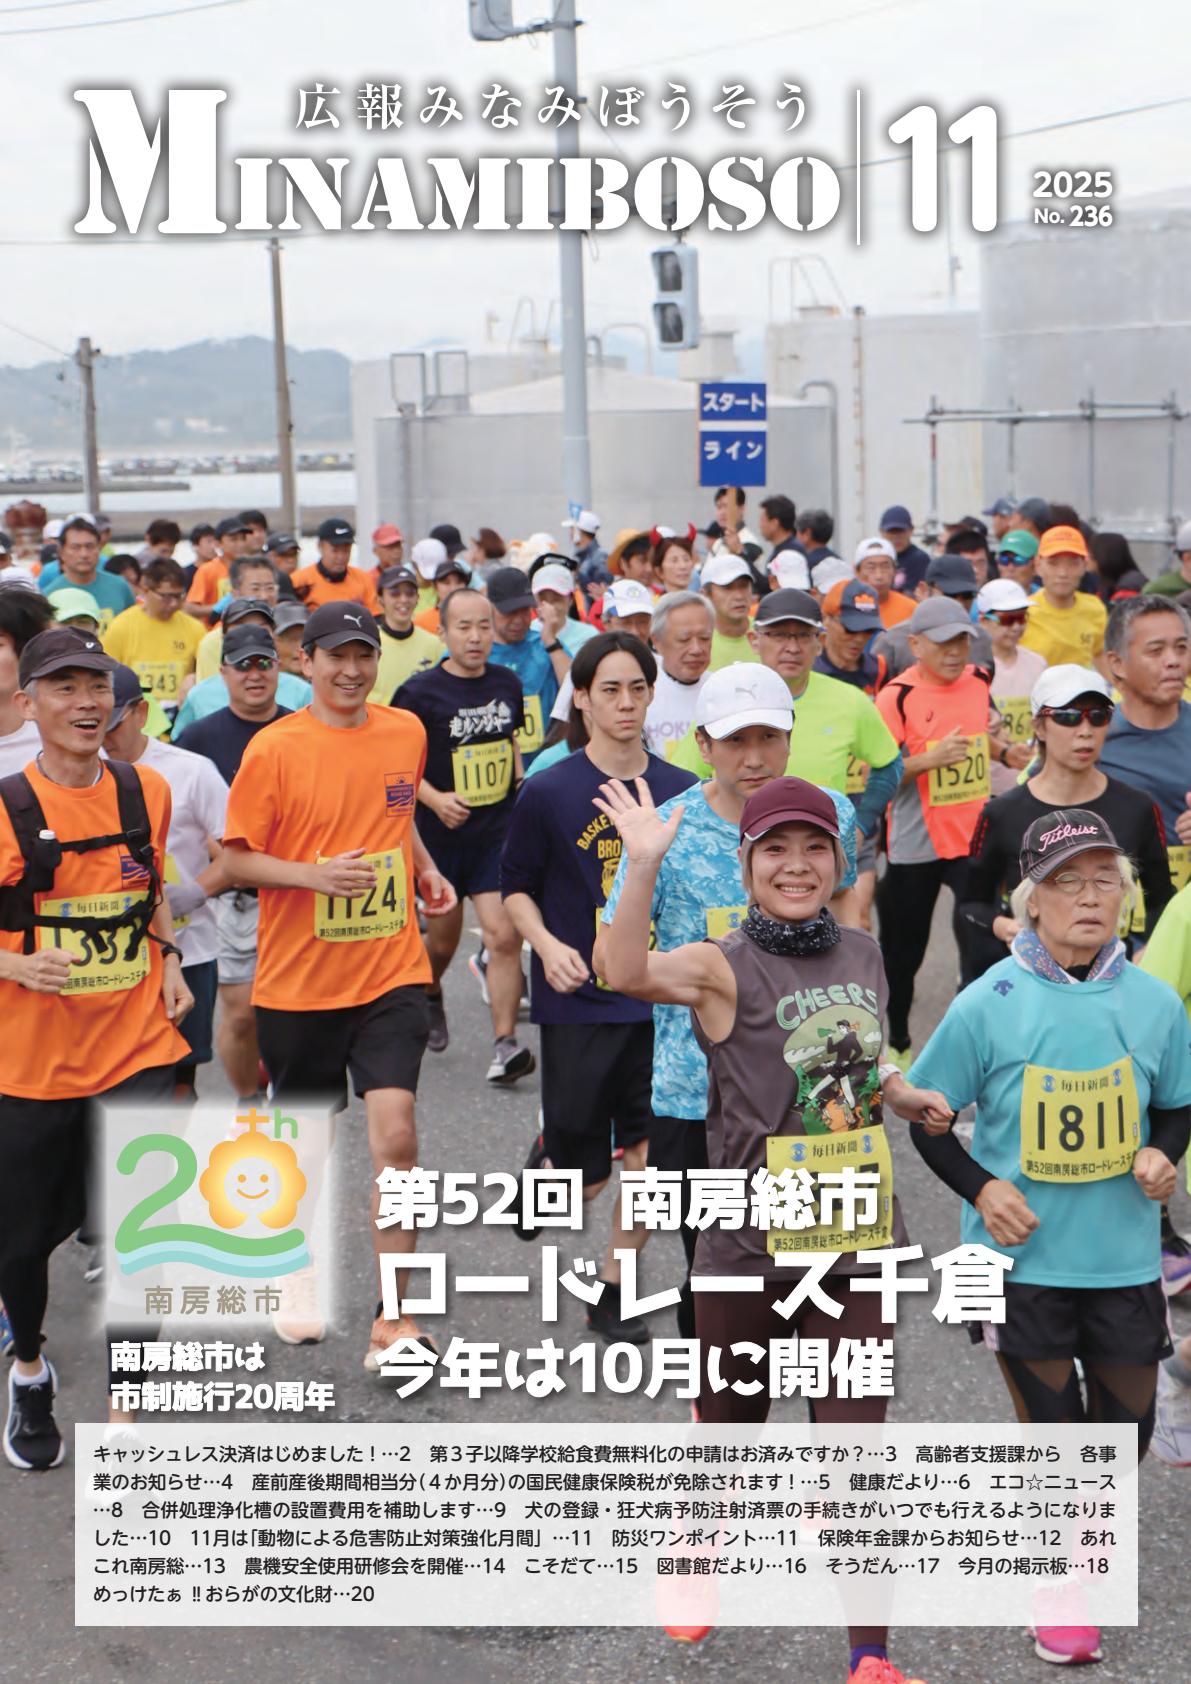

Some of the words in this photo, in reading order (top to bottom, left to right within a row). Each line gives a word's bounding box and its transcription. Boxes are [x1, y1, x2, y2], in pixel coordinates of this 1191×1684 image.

[703, 392, 765, 412] スタート
[703, 441, 763, 461] ライン
[462, 758, 508, 791] 1107
[936, 753, 986, 789] 1520
[1038, 824, 1098, 852] Titleist
[328, 875, 396, 920] 1124
[776, 982, 879, 1031] CHEERS
[1061, 1077, 1109, 1092] 毎日新聞
[1037, 1095, 1125, 1152] 1811
[812, 1141, 858, 1158] 毎日新聞
[1026, 1152, 1137, 1177] 第52回南房総市ロードレース千
